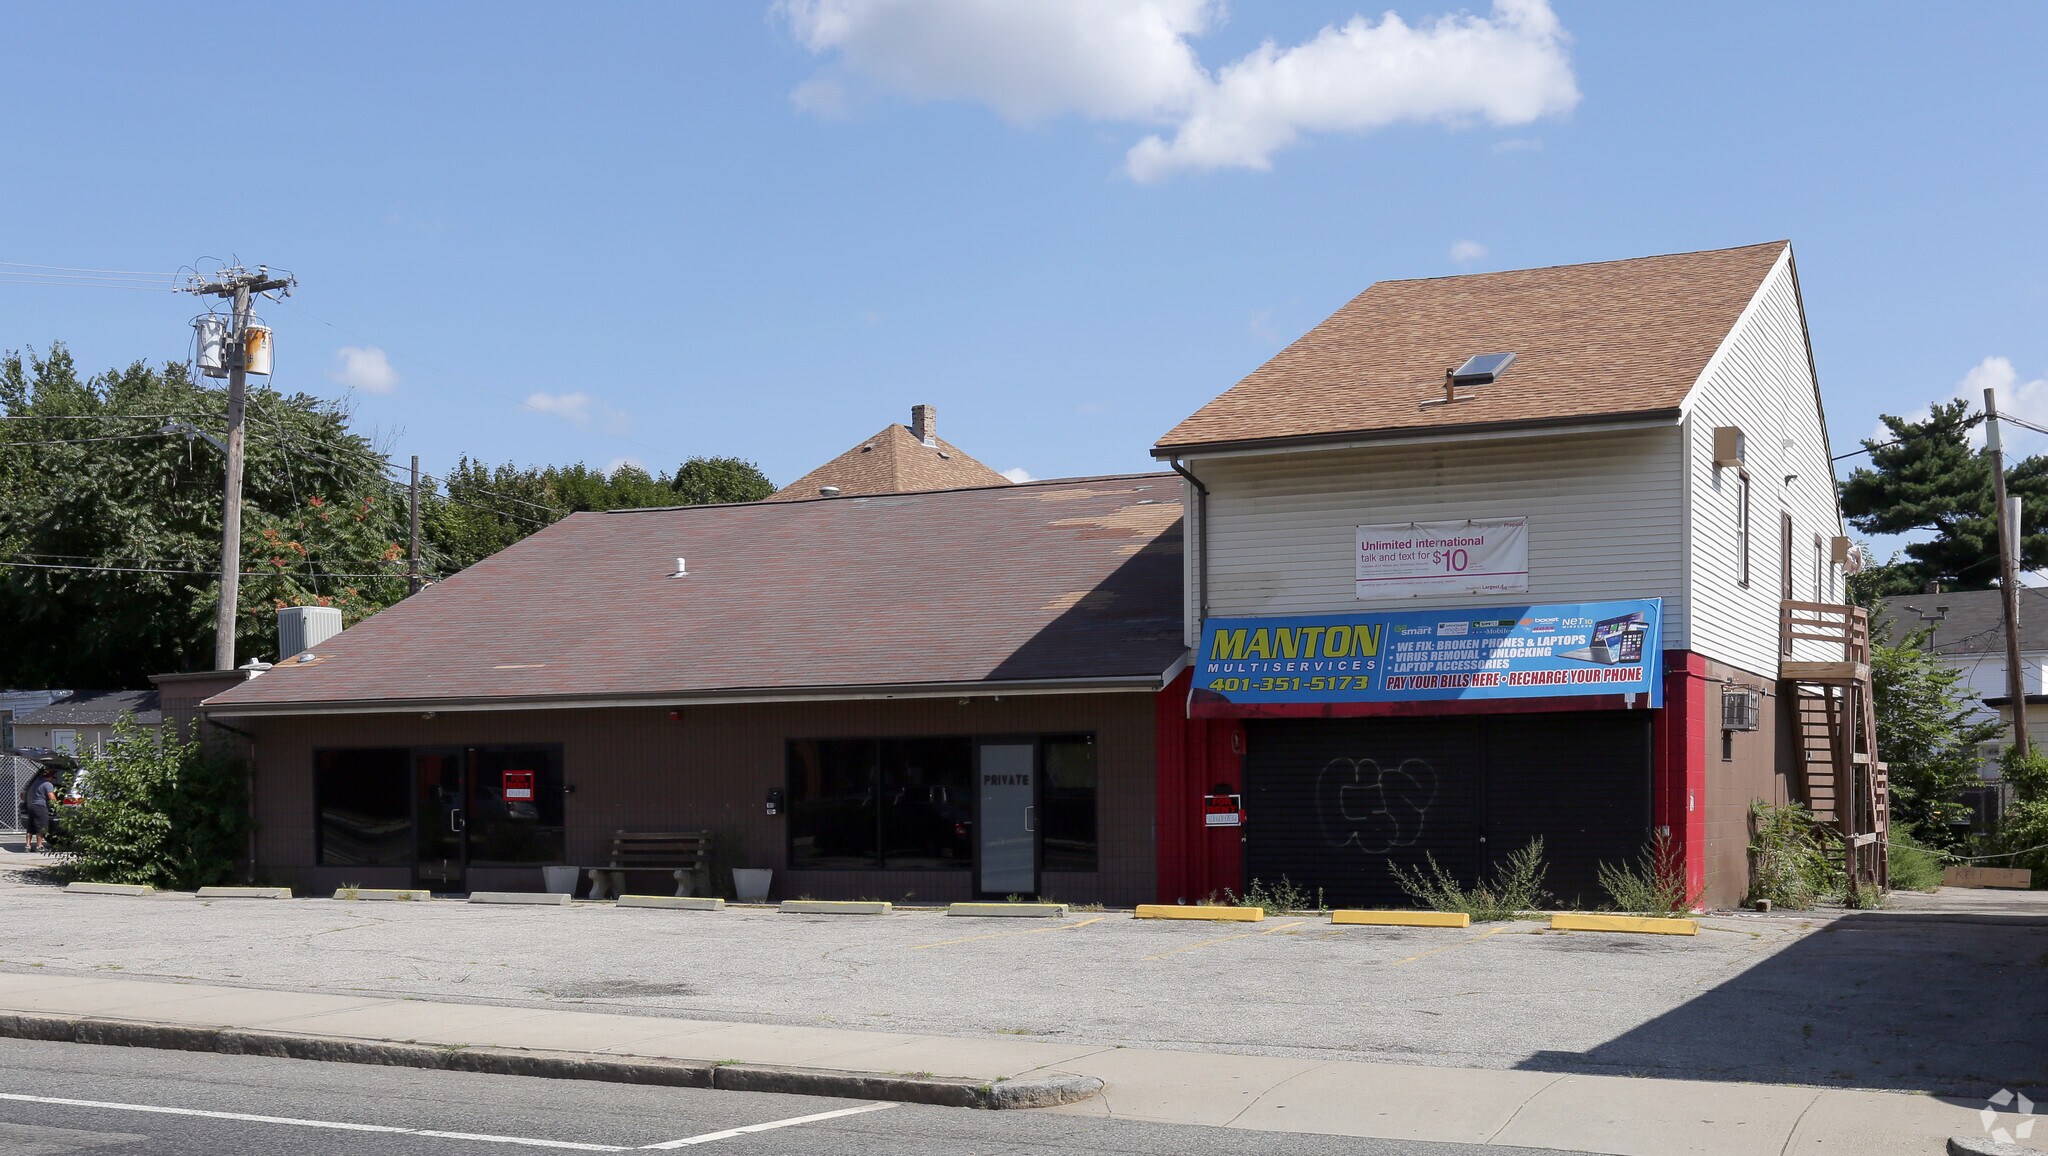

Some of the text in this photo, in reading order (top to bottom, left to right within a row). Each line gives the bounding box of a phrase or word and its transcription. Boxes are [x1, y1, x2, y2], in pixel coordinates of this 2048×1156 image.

[1361, 536, 1484, 551] Unlimited international
[1361, 550, 1430, 563] talk and text for
[1432, 548, 1468, 572] $10
[1401, 626, 1432, 636] smart
[1209, 624, 1382, 660] MANTON
[1397, 635, 1586, 652] WE FIX: BROKEN PHONES & LAPTOPS
[1395, 647, 1552, 662] VIRUS REMOVAL UNLOCKING
[1207, 660, 1376, 673] MULTISERVICES
[1393, 659, 1510, 673] LAPTOP ACCESSORIES
[1208, 675, 1370, 692] 401-351-5173
[1386, 666, 1643, 690] PAY YOUR BILLS HERE RECHARGE YOUR PHONE
[983, 774, 1030, 786] PRIVATE
[1211, 798, 1233, 806] FOR
[1207, 805, 1237, 814] RENT
[1955, 869, 2015, 880] KEEP OUT
